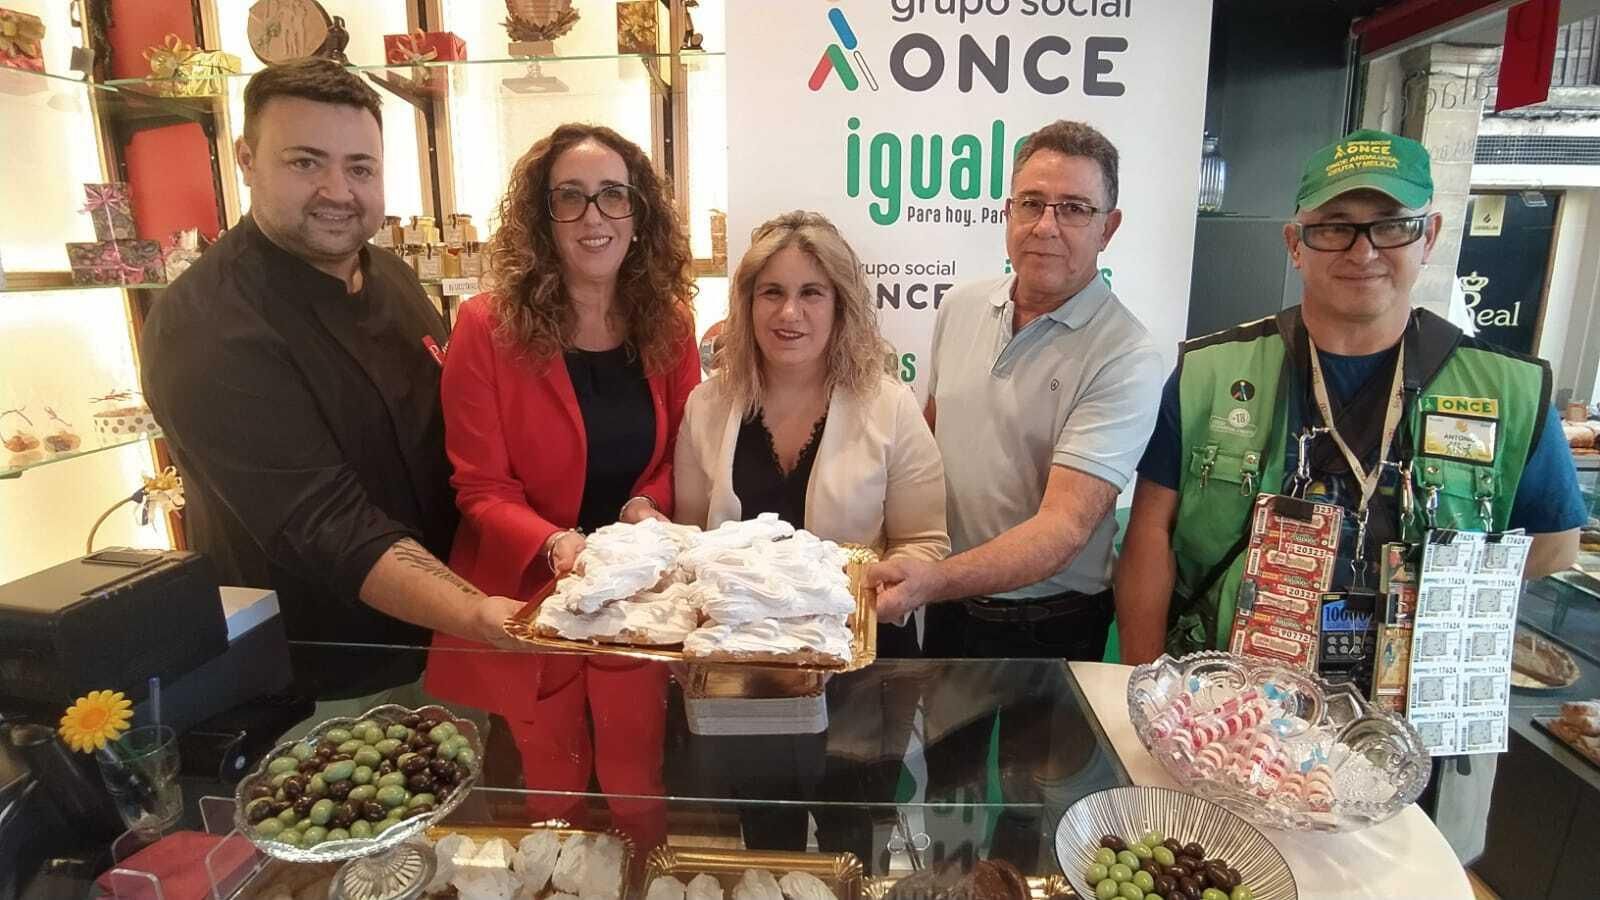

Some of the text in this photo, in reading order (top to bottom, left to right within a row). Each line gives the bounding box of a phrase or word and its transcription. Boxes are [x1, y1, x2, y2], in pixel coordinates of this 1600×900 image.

[892, 0, 1131, 23] grupo social
[889, 32, 1129, 97] ONCE
[1347, 146, 1391, 155] ONCE
[846, 117, 1028, 226] igual
[907, 205, 1006, 227] Para hoy. Par
[860, 260, 956, 278] rupo social
[876, 282, 954, 310] NCE
[1461, 290, 1521, 333] Real
[1442, 400, 1492, 413] ONCE
